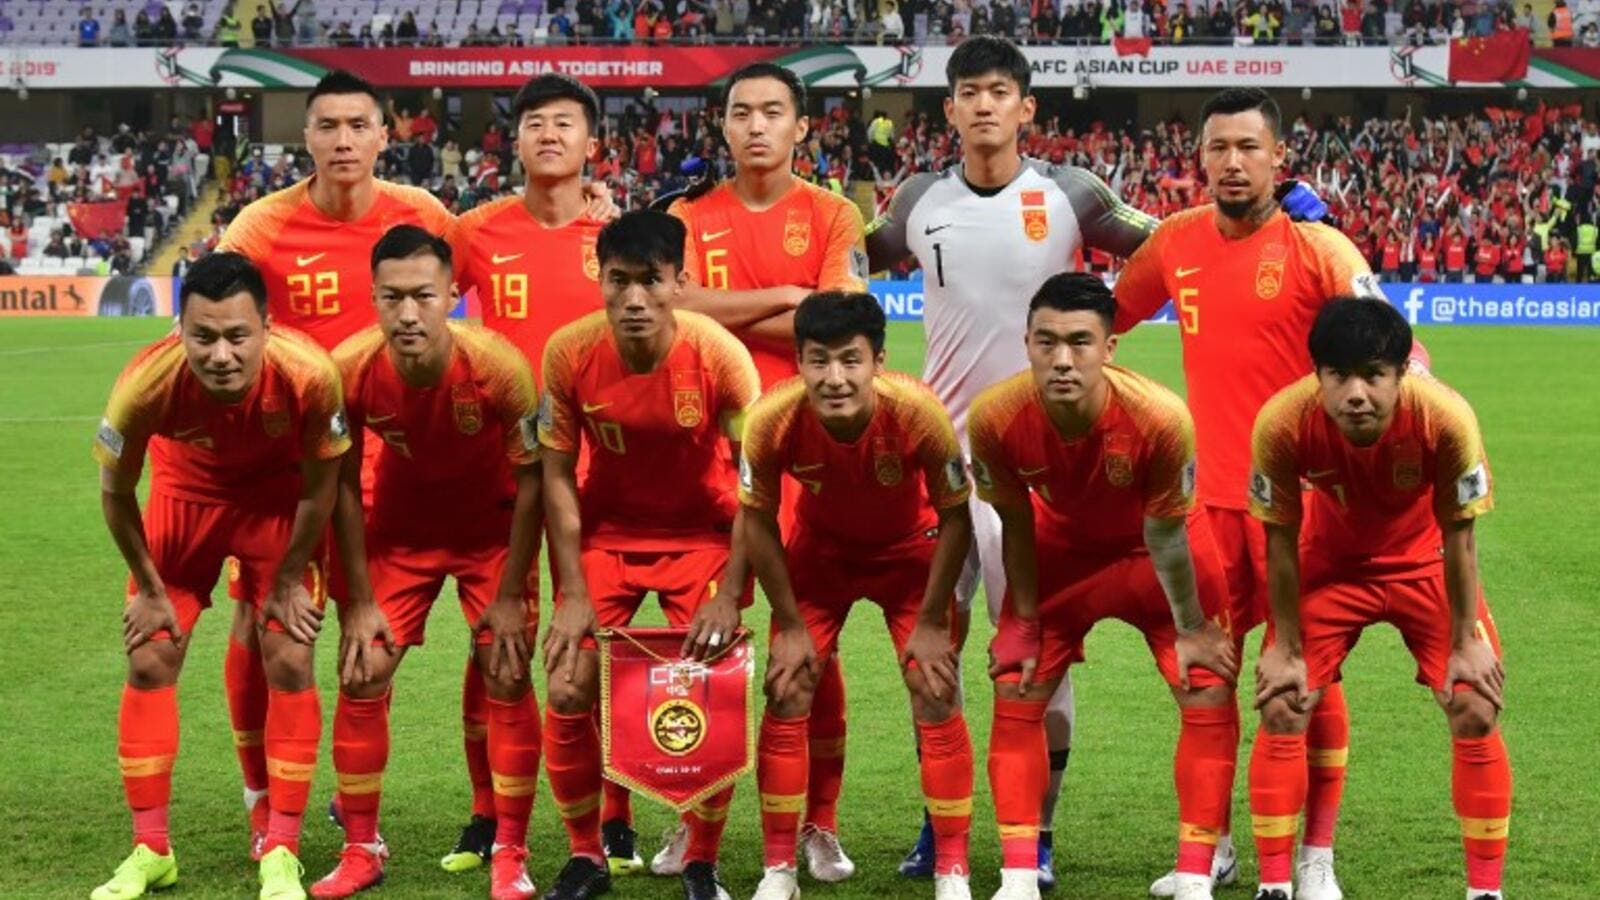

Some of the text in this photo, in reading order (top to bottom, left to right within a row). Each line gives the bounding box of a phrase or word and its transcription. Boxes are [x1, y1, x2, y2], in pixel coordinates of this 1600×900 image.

[410, 61, 663, 76] BRINGING ASIA TOGETHER
[1030, 60, 1283, 75] AFC ASIAN CUP UAE 2019
[933, 243, 944, 287] 1
[287, 271, 340, 315] 22
[491, 274, 527, 319] 19
[870, 293, 924, 315] NC
[1180, 288, 1199, 334] 5
